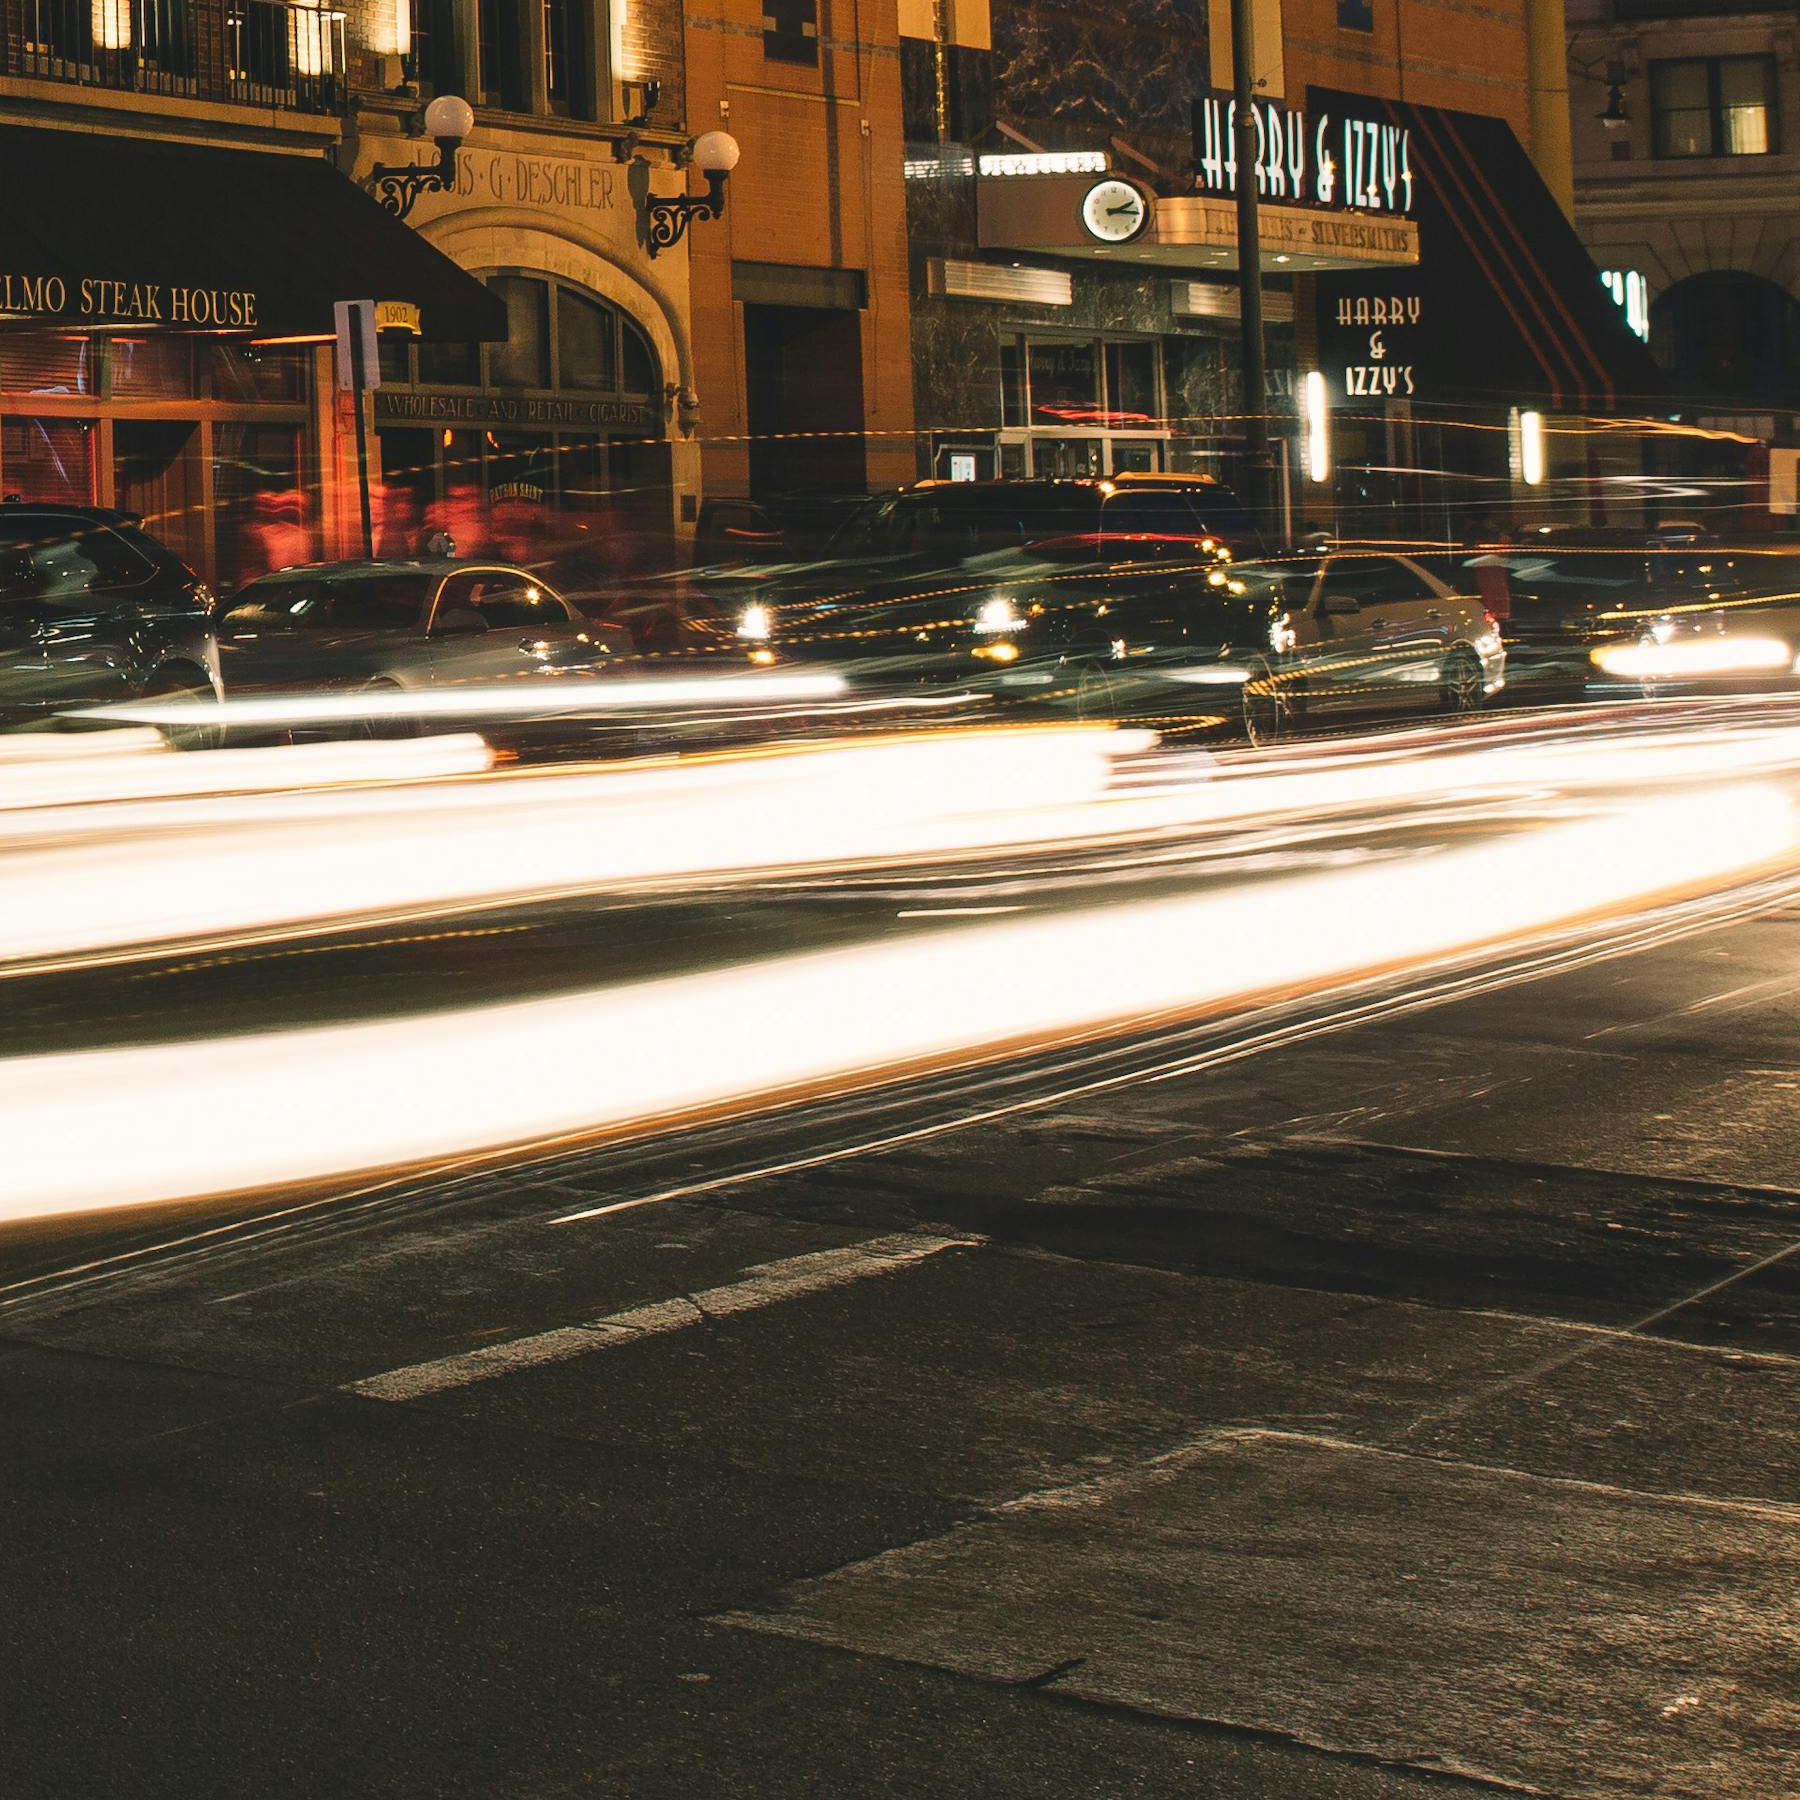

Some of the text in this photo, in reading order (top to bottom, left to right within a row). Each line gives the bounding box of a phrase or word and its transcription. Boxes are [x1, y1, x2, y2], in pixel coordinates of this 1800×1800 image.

[1344, 118, 1413, 212] IZZY'S
[81, 279, 161, 320] STEAK
[171, 287, 258, 327] HOUSE
[384, 305, 408, 323] 1902
[1336, 296, 1421, 326] HARRY
[1369, 330, 1387, 359] &
[1346, 366, 1414, 396] IZZY'S
[387, 393, 474, 418] WHOLESALE
[528, 402, 573, 421] RETAIL
